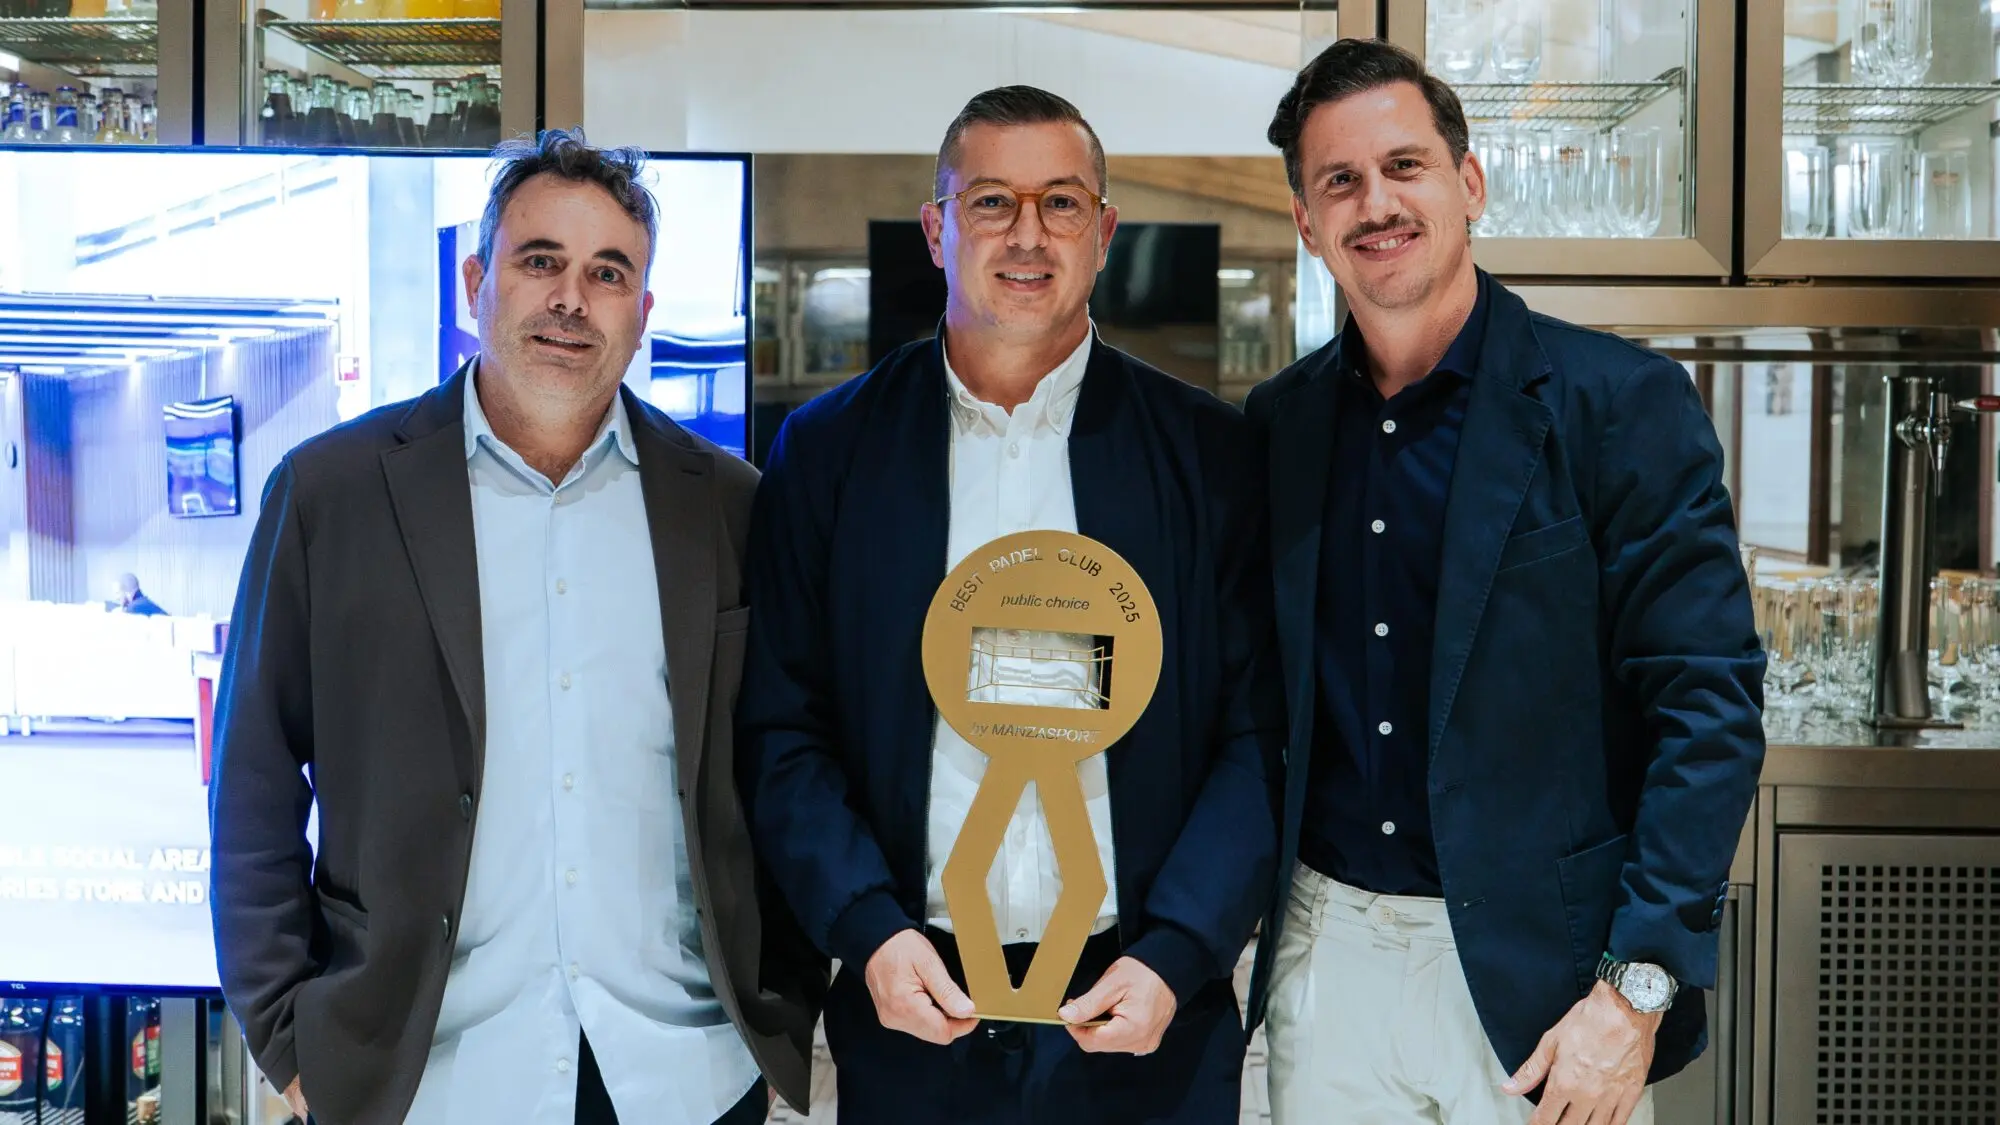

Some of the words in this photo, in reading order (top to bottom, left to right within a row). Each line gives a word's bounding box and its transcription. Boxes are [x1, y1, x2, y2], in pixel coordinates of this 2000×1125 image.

[950, 571, 984, 612] BEST
[989, 547, 1043, 574] PADEL
[1057, 548, 1102, 577] CLUB
[1109, 582, 1141, 624] 2025
[1000, 594, 1042, 608] public
[1045, 596, 1090, 611] choice
[970, 722, 989, 737] by
[64, 877, 145, 904] STORE
[150, 881, 204, 905] AND
